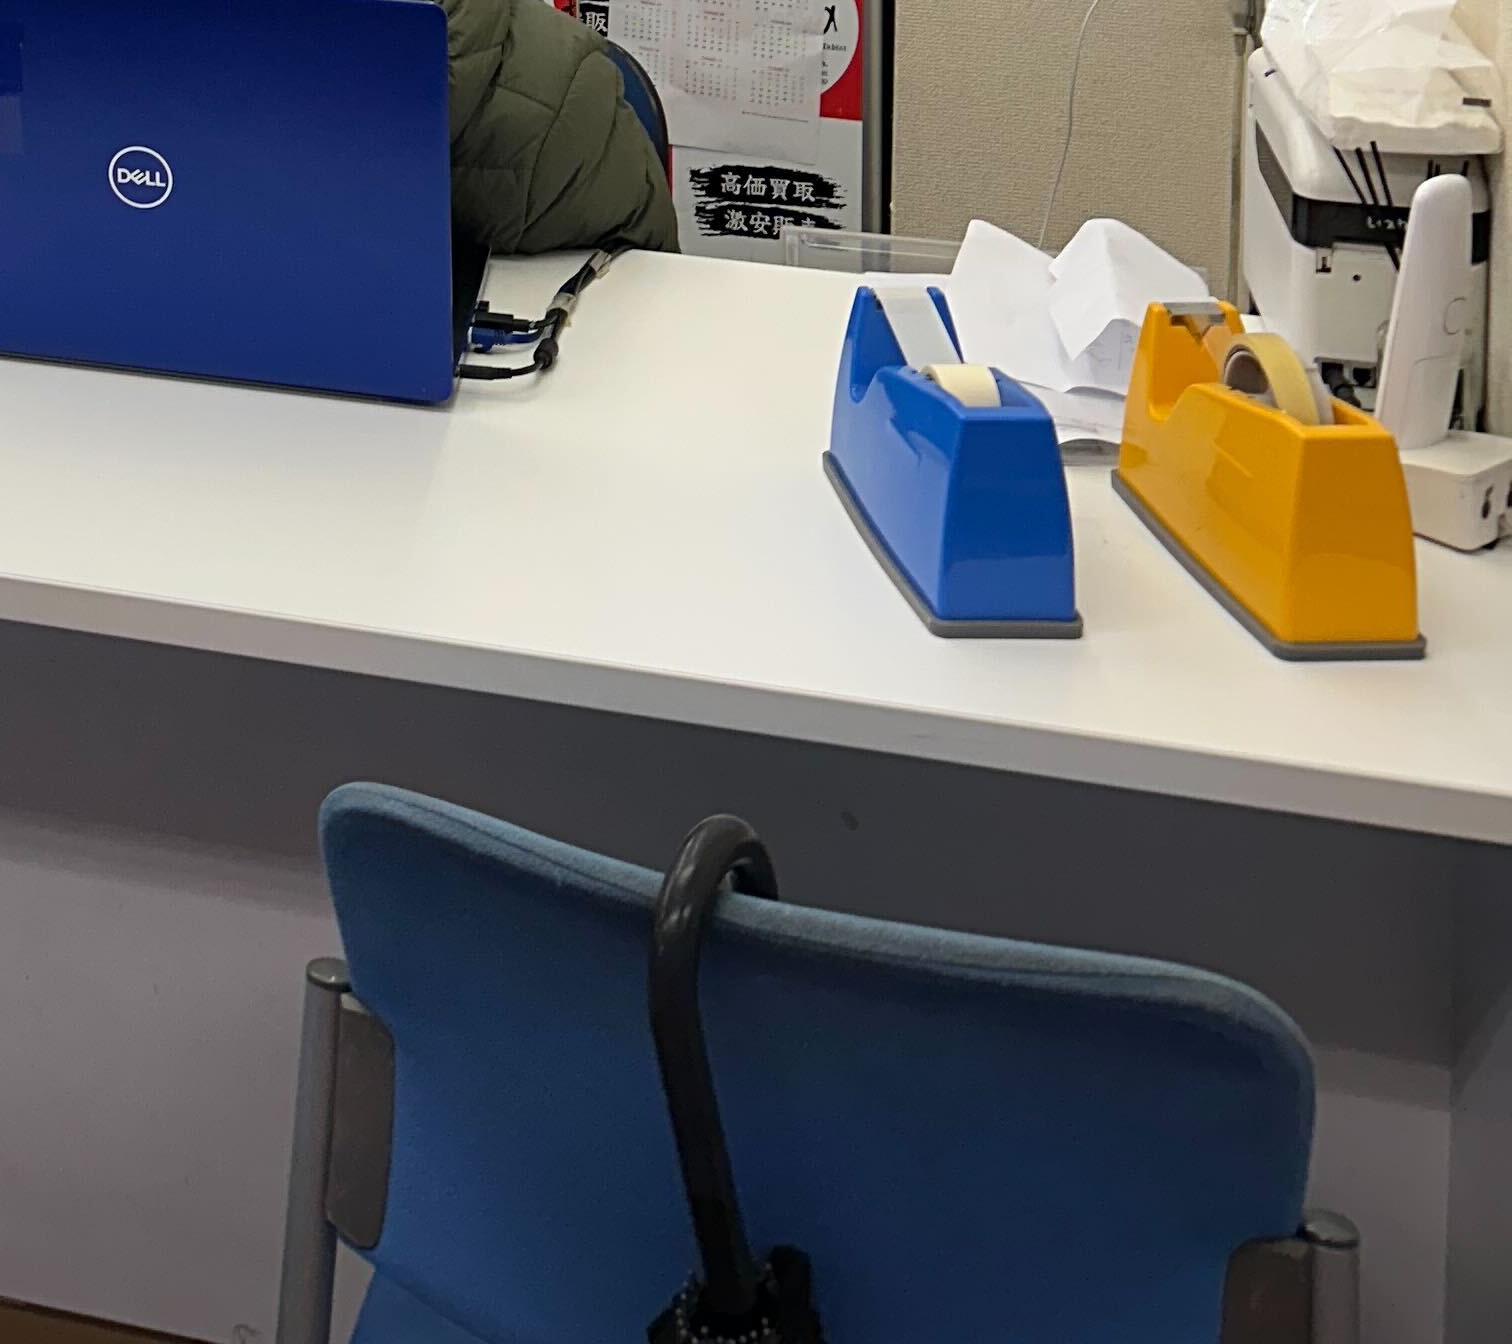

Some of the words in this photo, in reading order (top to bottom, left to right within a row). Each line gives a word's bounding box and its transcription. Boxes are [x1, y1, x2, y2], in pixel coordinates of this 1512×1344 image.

[118, 168, 166, 187] DELL
[721, 172, 816, 202] 高価買取
